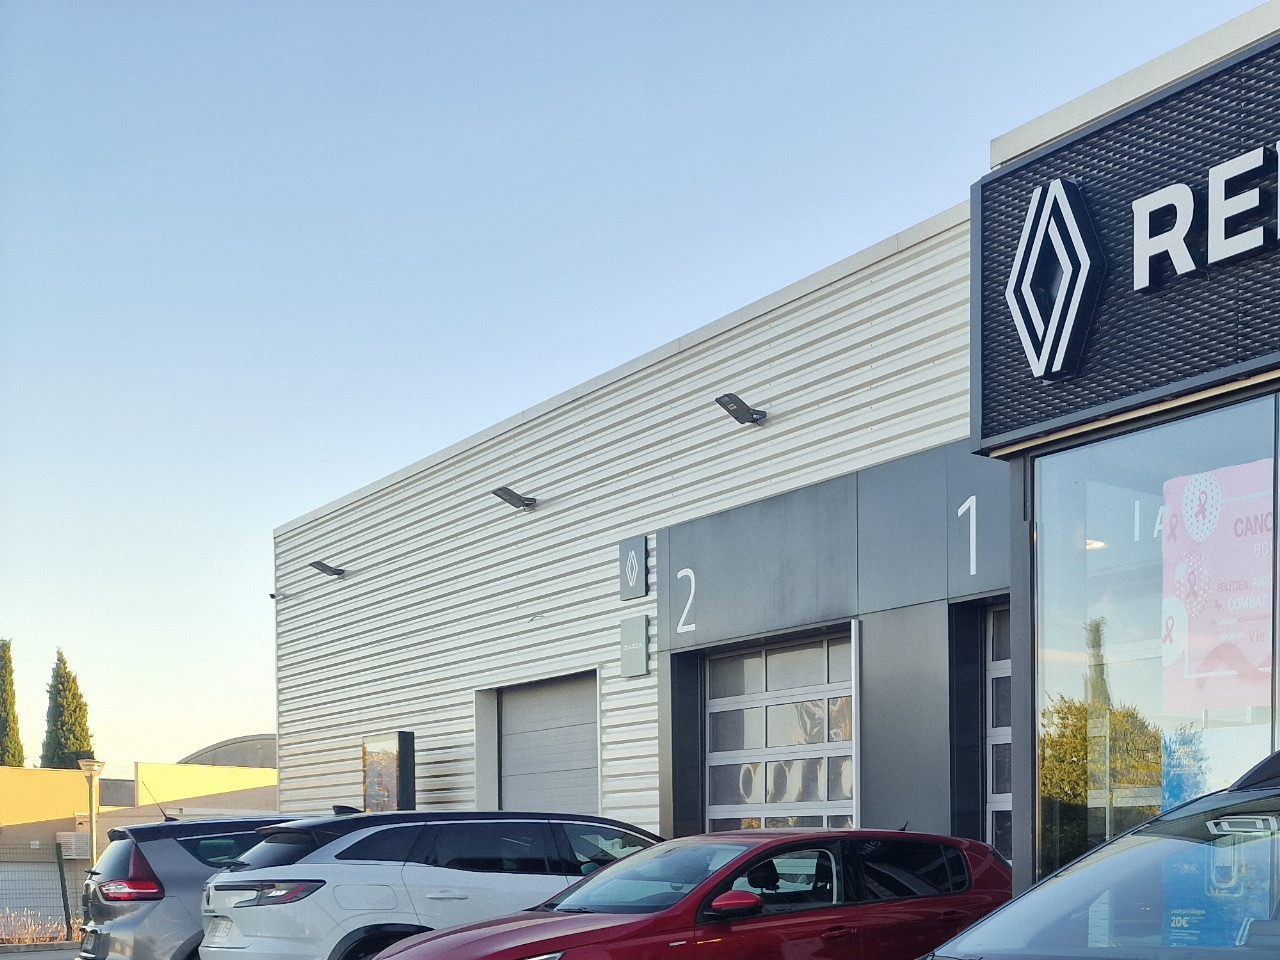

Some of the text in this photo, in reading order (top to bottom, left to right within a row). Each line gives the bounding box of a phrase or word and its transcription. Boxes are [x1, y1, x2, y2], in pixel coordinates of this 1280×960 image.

[957, 495, 976, 576] 1
[676, 568, 696, 634] 2
[1171, 917, 1189, 927] 20€
